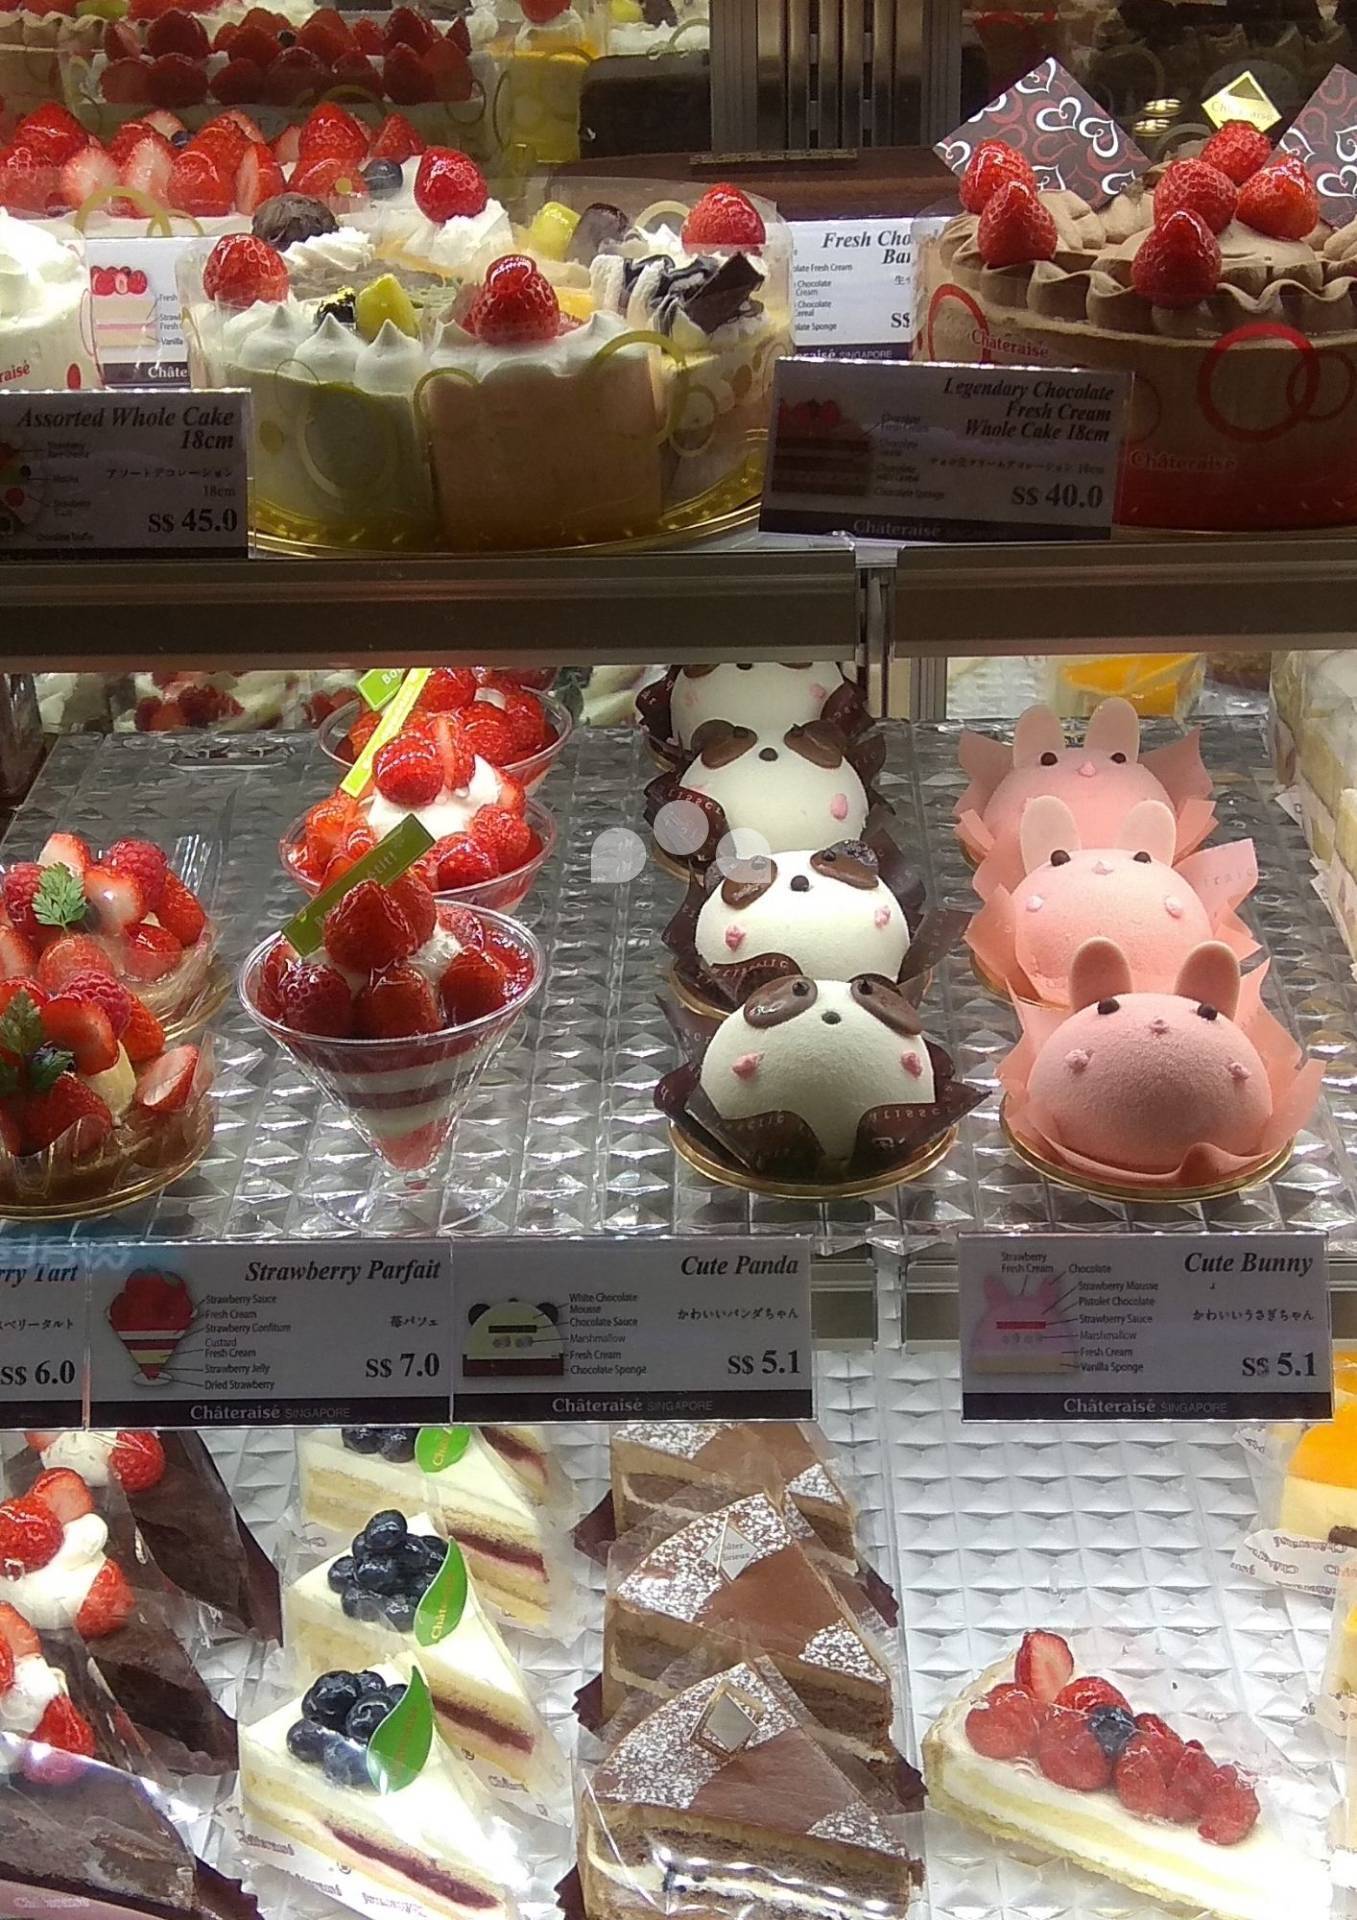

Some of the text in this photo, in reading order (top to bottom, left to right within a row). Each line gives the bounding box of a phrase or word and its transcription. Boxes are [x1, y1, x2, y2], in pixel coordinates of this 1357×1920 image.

[821, 231, 871, 248] Fresh
[811, 264, 829, 272] Fresh
[830, 263, 853, 272] Cream
[797, 280, 831, 288] Chocolate
[895, 275, 911, 285] 生
[159, 293, 178, 302] Fresh
[798, 300, 832, 308] Chocolate
[160, 322, 178, 330] Fresh
[812, 322, 837, 332] Sponge
[148, 365, 188, 379] Châte
[943, 378, 1115, 401] Legendary Chocolate
[1006, 400, 1112, 422] Fresh Cream
[18, 406, 234, 428] Assorted Whole Cake
[964, 418, 1111, 443] Whole Cake 18cm
[180, 430, 234, 449] 18cm
[203, 485, 236, 497] 18cm
[1045, 483, 1104, 509] 40.0
[182, 508, 238, 532] 45.0
[1001, 1252, 1047, 1263] Strawberry
[680, 1255, 798, 1276] Cute Panda
[1001, 1264, 1054, 1273] Fresh Cream
[1068, 1263, 1112, 1274] Chocolate
[1184, 1252, 1313, 1277] Cute Bunny
[34, 1263, 78, 1282] Tart
[245, 1260, 441, 1285] Strawberry Parfait
[1078, 1281, 1159, 1292] Strawberry Mousse
[205, 1294, 277, 1305] Strawberry Sauce
[569, 1292, 638, 1302] White Chocolate
[1112, 1297, 1155, 1307] Chocolate
[205, 1310, 257, 1319] Fresh Cream
[569, 1305, 601, 1314] Mousse
[677, 1308, 798, 1320] かわいいパンダちゃん
[1192, 1308, 1314, 1321] かわいいうさぎちゃん
[569, 1317, 638, 1327] Chocolate Sauce
[1079, 1314, 1152, 1325] Strawberry Sauce
[205, 1324, 250, 1334] Strawberry
[569, 1334, 626, 1343] Marshmallow
[1080, 1331, 1137, 1340] Marshmallow
[205, 1337, 237, 1347] Custard
[205, 1349, 256, 1358] Fresh Cream
[569, 1350, 622, 1360] Fresh Cream
[1080, 1348, 1133, 1357] Fresh Cream
[365, 1352, 440, 1379] S$ 7.0
[727, 1350, 801, 1375] S$ 5.1
[1080, 1362, 1144, 1374] Vanilla Sponge
[1276, 1352, 1317, 1377] 5.1
[1, 1360, 75, 1386] S$ 6.0
[205, 1364, 270, 1375] Strawberry Jelly
[570, 1365, 647, 1377] Chocolate Sponge
[205, 1380, 275, 1391] Dried Strawberry
[552, 1398, 713, 1413] Châteraisé SINGAPORE
[1063, 1398, 1228, 1414] Châteraisé SINGAPORE
[190, 1404, 351, 1420] Châteraisé SINGAPORE
